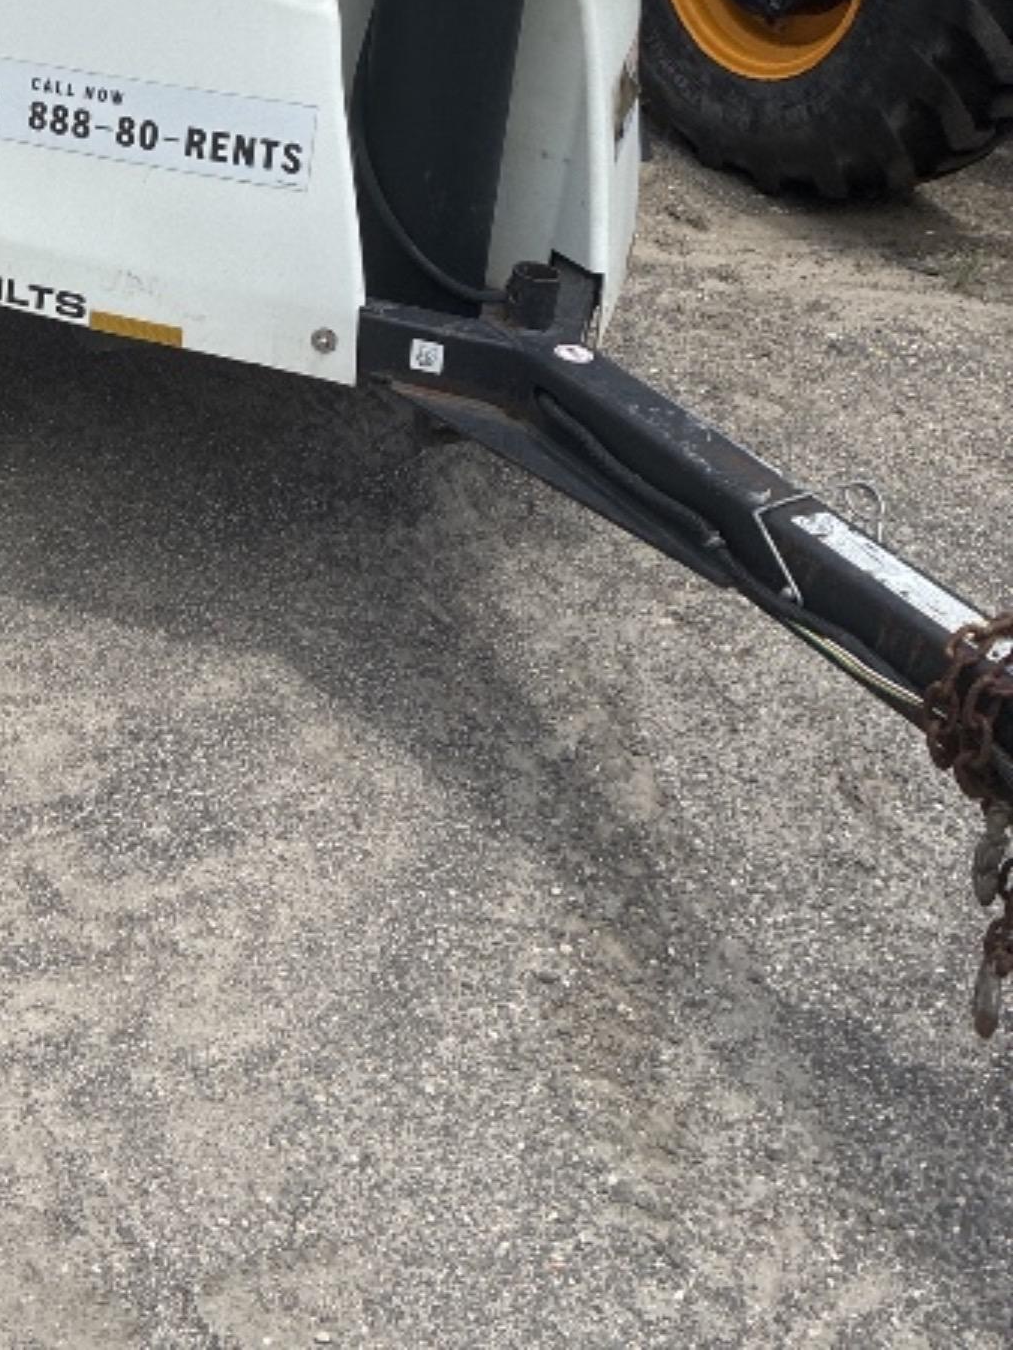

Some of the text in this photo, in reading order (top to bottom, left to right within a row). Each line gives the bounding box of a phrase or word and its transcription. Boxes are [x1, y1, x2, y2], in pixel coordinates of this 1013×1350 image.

[30, 77, 126, 106] CALL NOW
[28, 100, 304, 176] 888-80-RENTS
